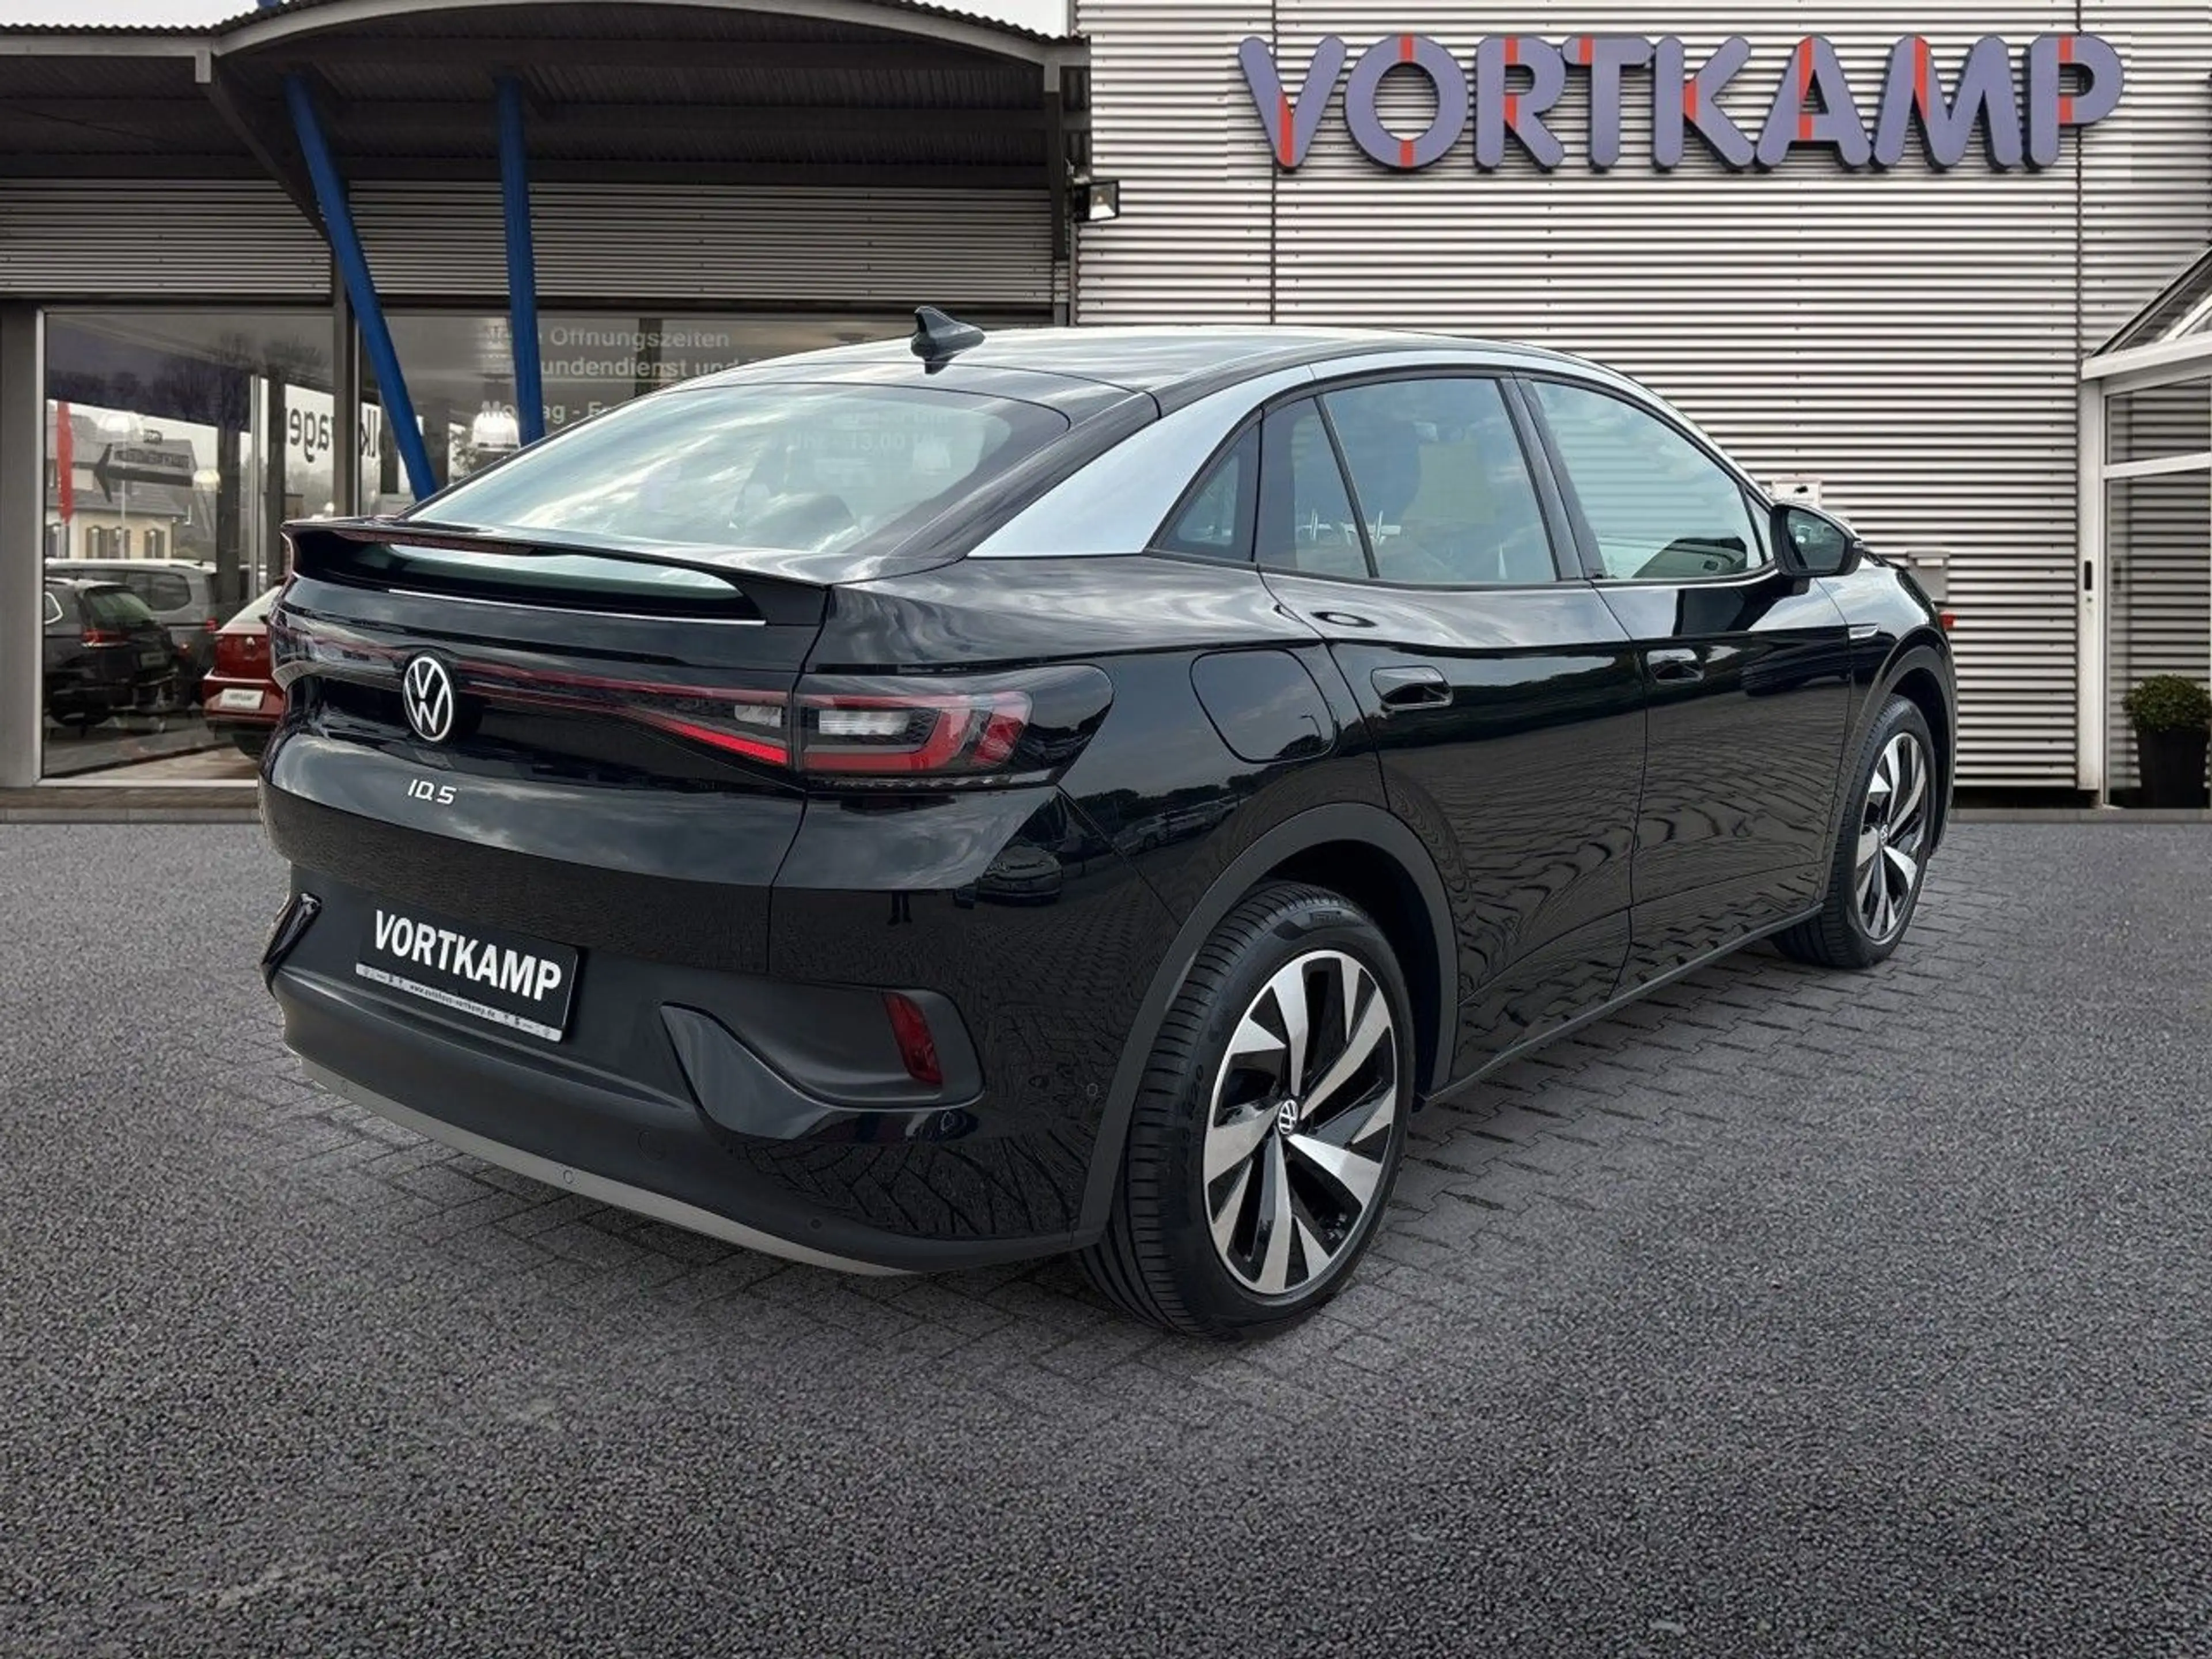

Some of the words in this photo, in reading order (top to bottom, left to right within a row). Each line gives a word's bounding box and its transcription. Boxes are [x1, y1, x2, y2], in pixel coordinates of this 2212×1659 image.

[1238, 33, 2124, 169] VORTKAMP
[541, 357, 687, 377] undendienst
[375, 909, 562, 1001] VORTKAMP
